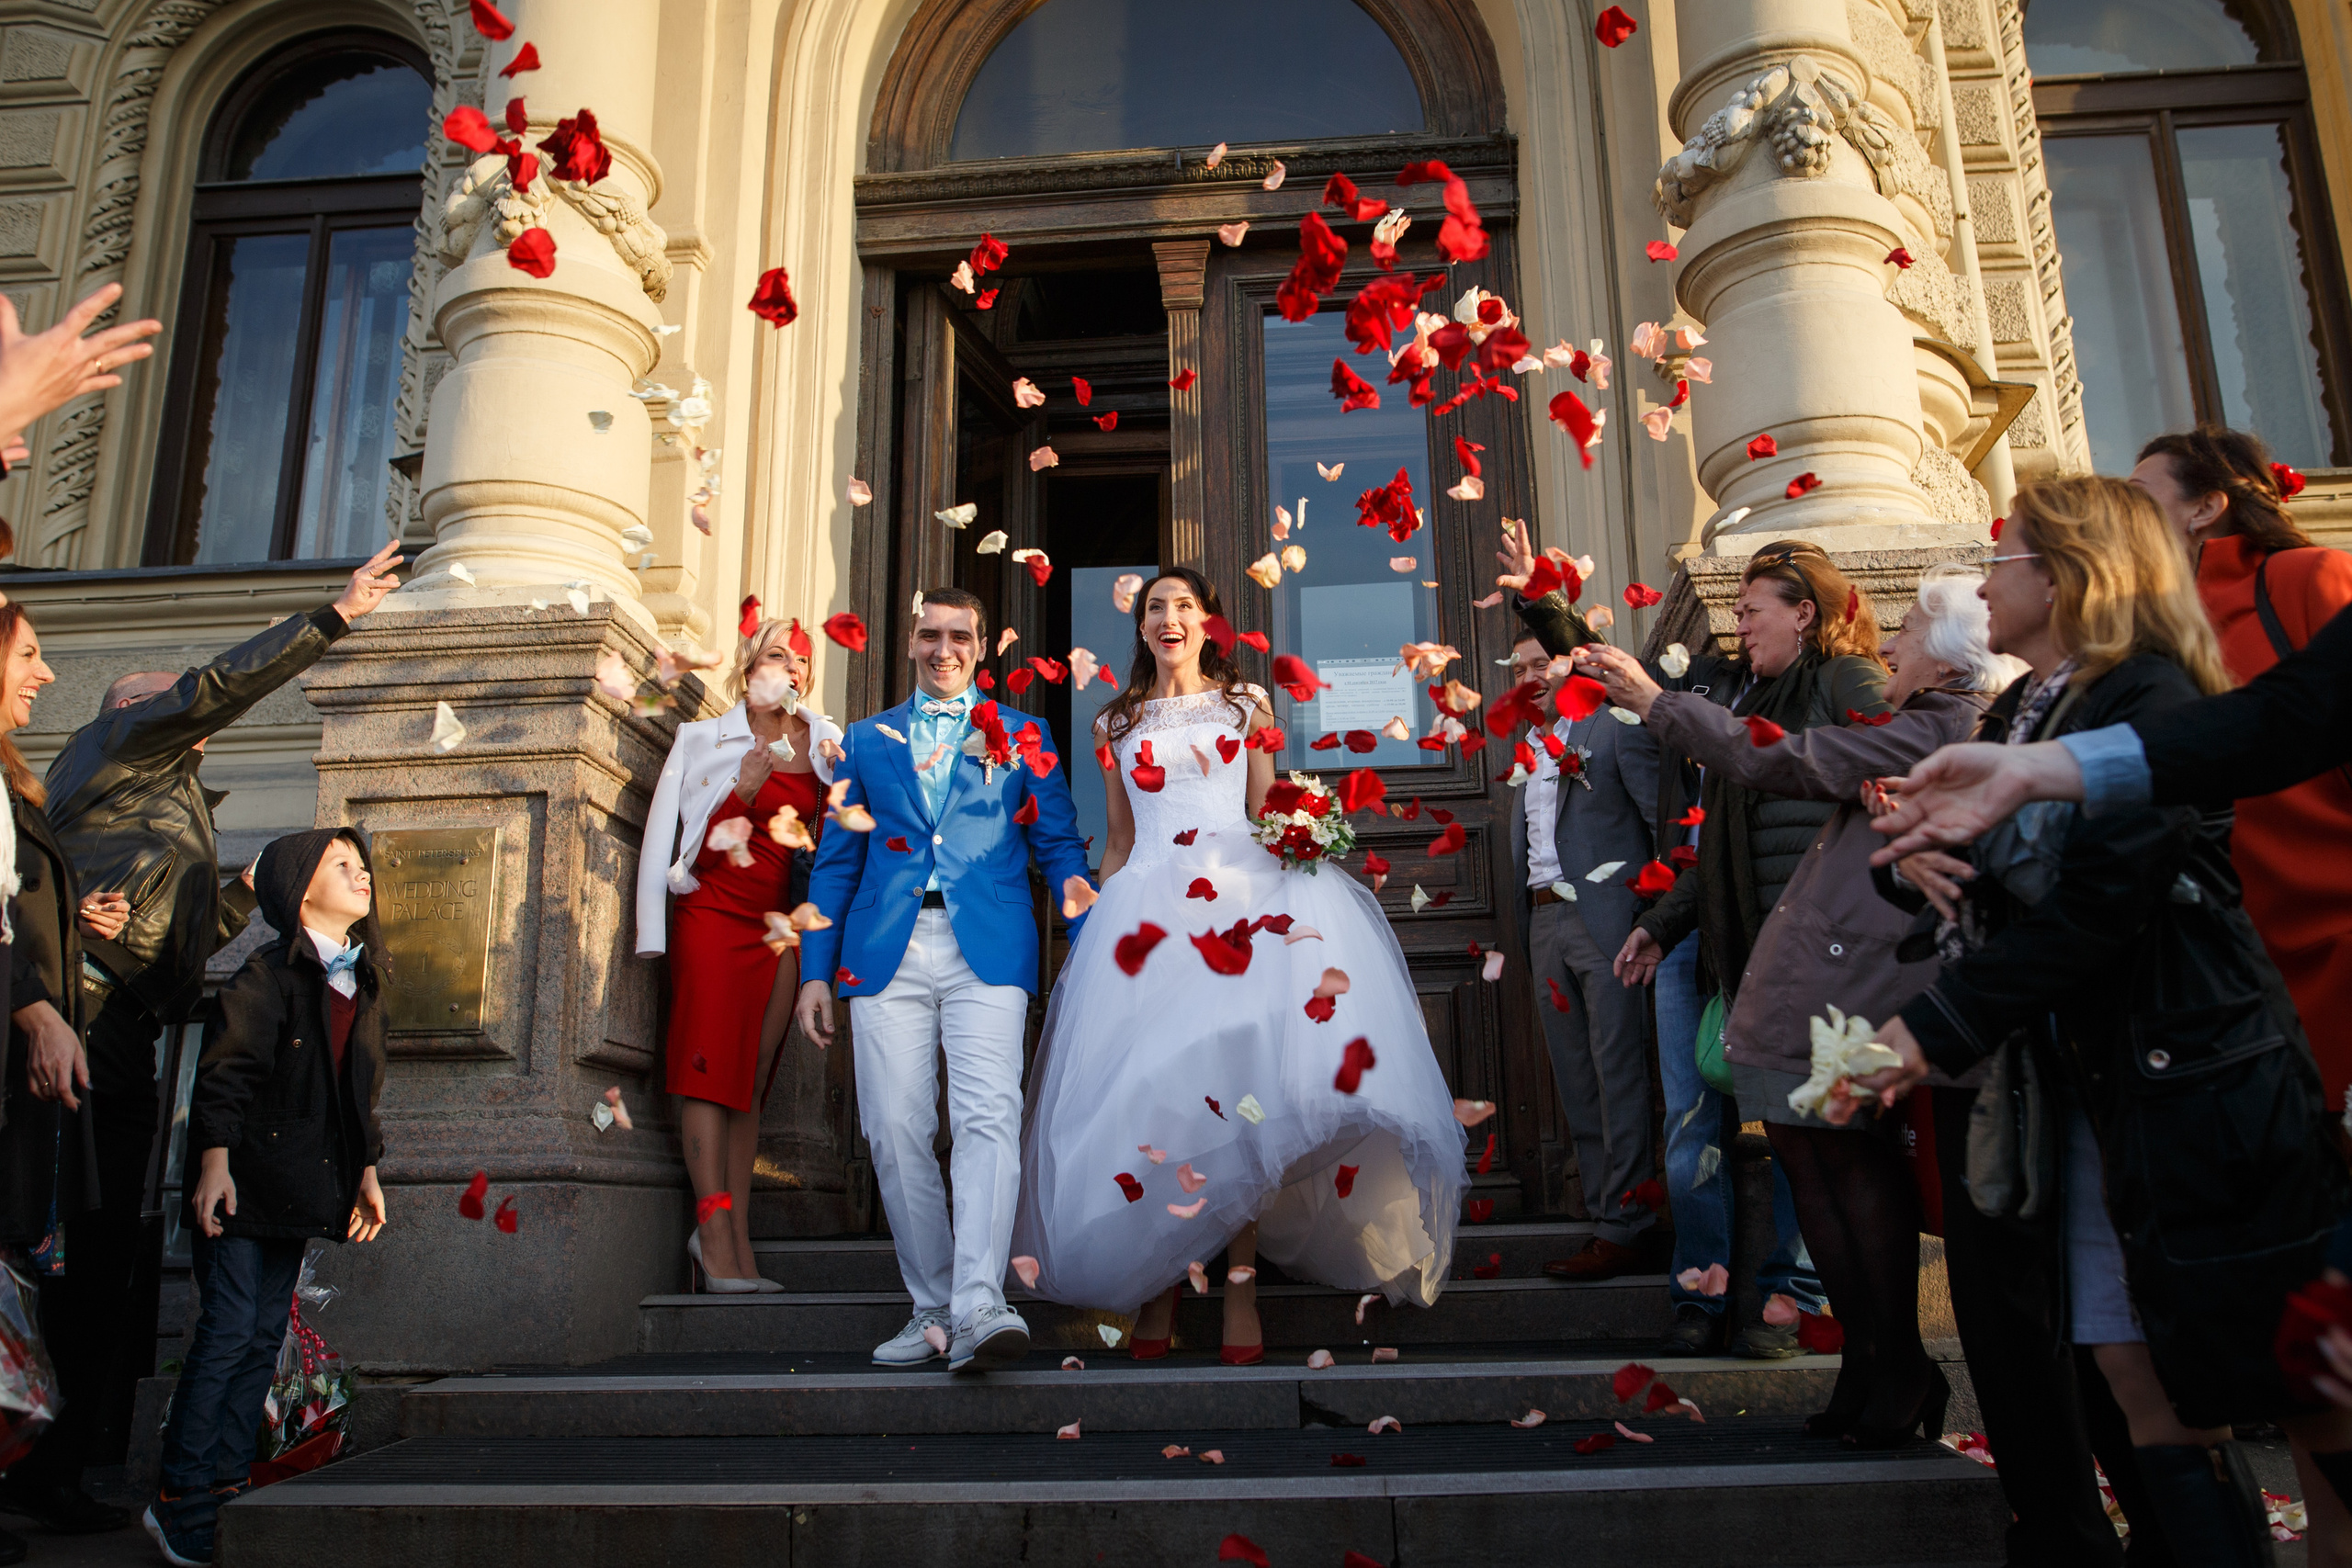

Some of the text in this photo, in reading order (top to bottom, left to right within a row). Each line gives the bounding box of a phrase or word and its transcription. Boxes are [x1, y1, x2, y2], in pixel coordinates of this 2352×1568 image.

[384, 848, 481, 859] SAINT PETERSBURG
[383, 880, 478, 899] WEDDING
[391, 902, 464, 921] PALACE
